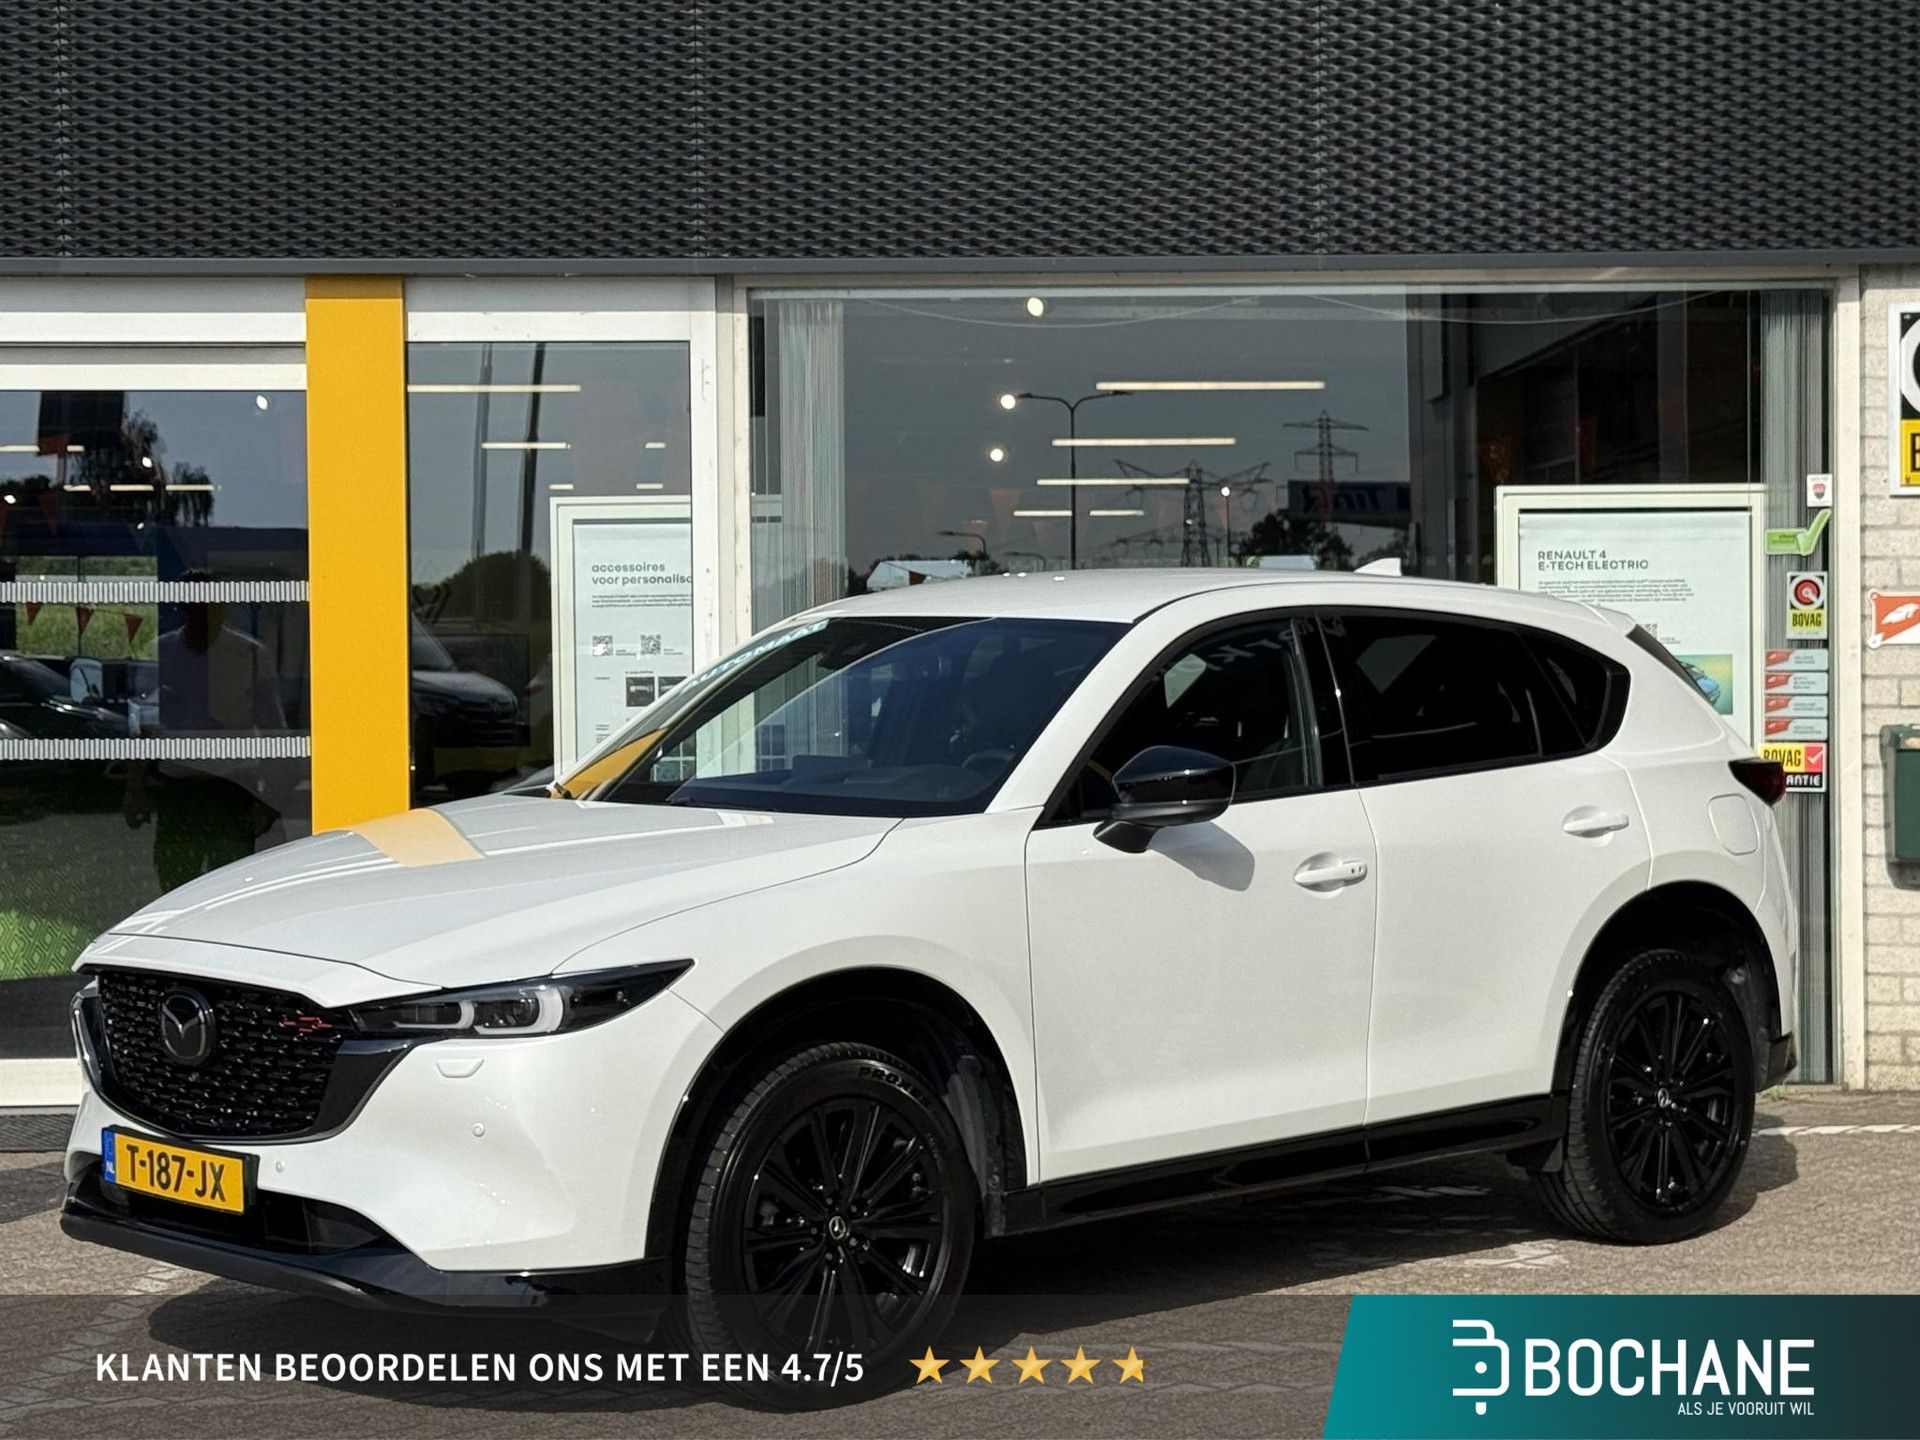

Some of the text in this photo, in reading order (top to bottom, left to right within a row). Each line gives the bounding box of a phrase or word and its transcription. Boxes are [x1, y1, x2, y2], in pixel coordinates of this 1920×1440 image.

[1538, 550, 1607, 560] RENAULT 4
[591, 562, 666, 573] accessoires
[1538, 560, 1649, 571] E-TECH ELECTRIC
[1792, 613, 1822, 627] BOVAG
[126, 1144, 226, 1202] T-187-JX
